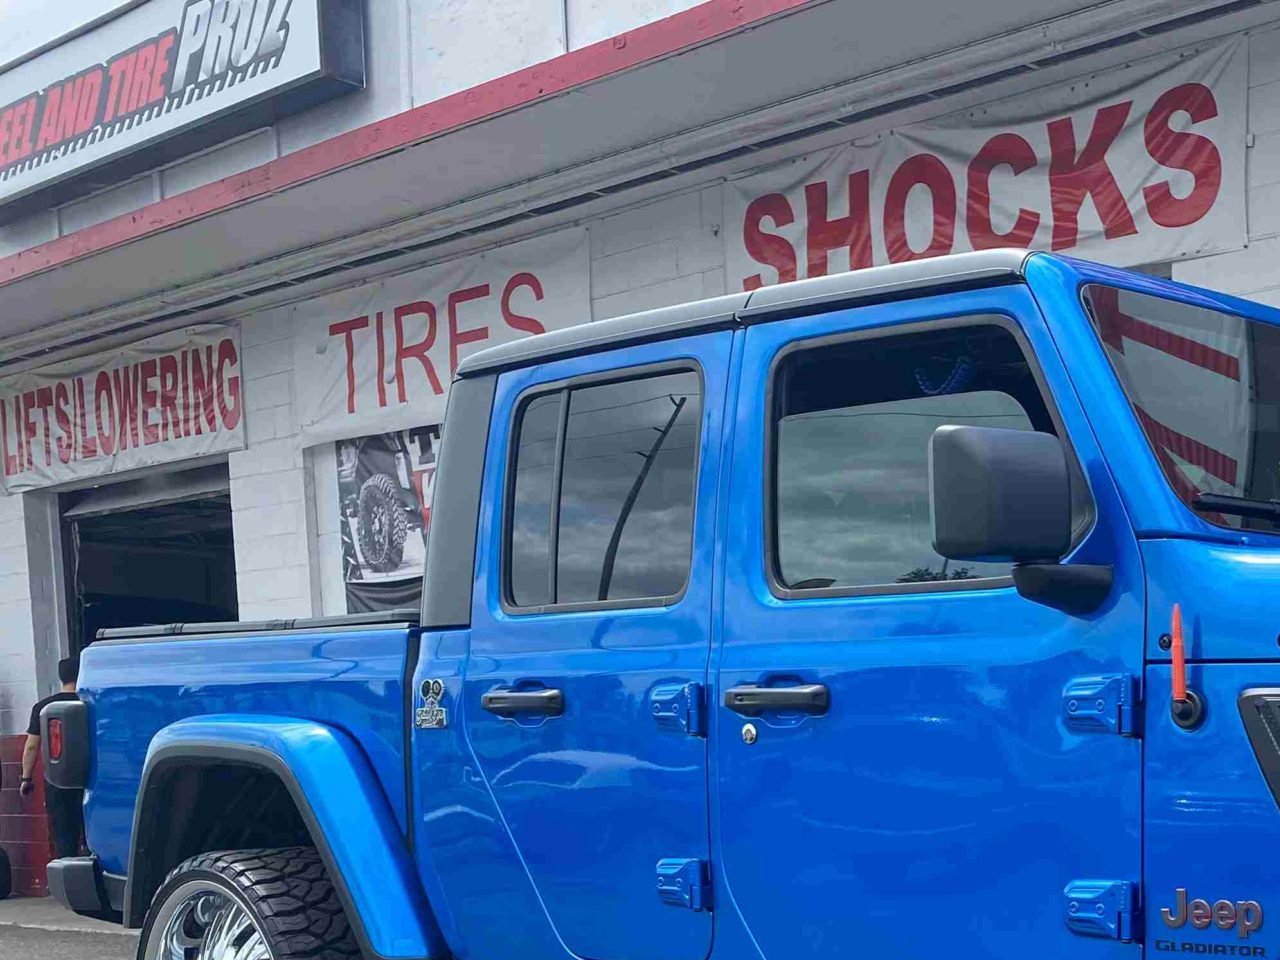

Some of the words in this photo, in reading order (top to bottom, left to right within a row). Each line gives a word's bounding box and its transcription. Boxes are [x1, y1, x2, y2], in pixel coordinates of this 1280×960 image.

[36, 70, 104, 151] AND
[103, 33, 175, 123] TIRE
[743, 82, 1222, 292] SHOCKS
[328, 272, 546, 414] TIRES
[1155, 940, 1268, 958] GLADIATOR
[1160, 888, 1263, 939] Jeep
